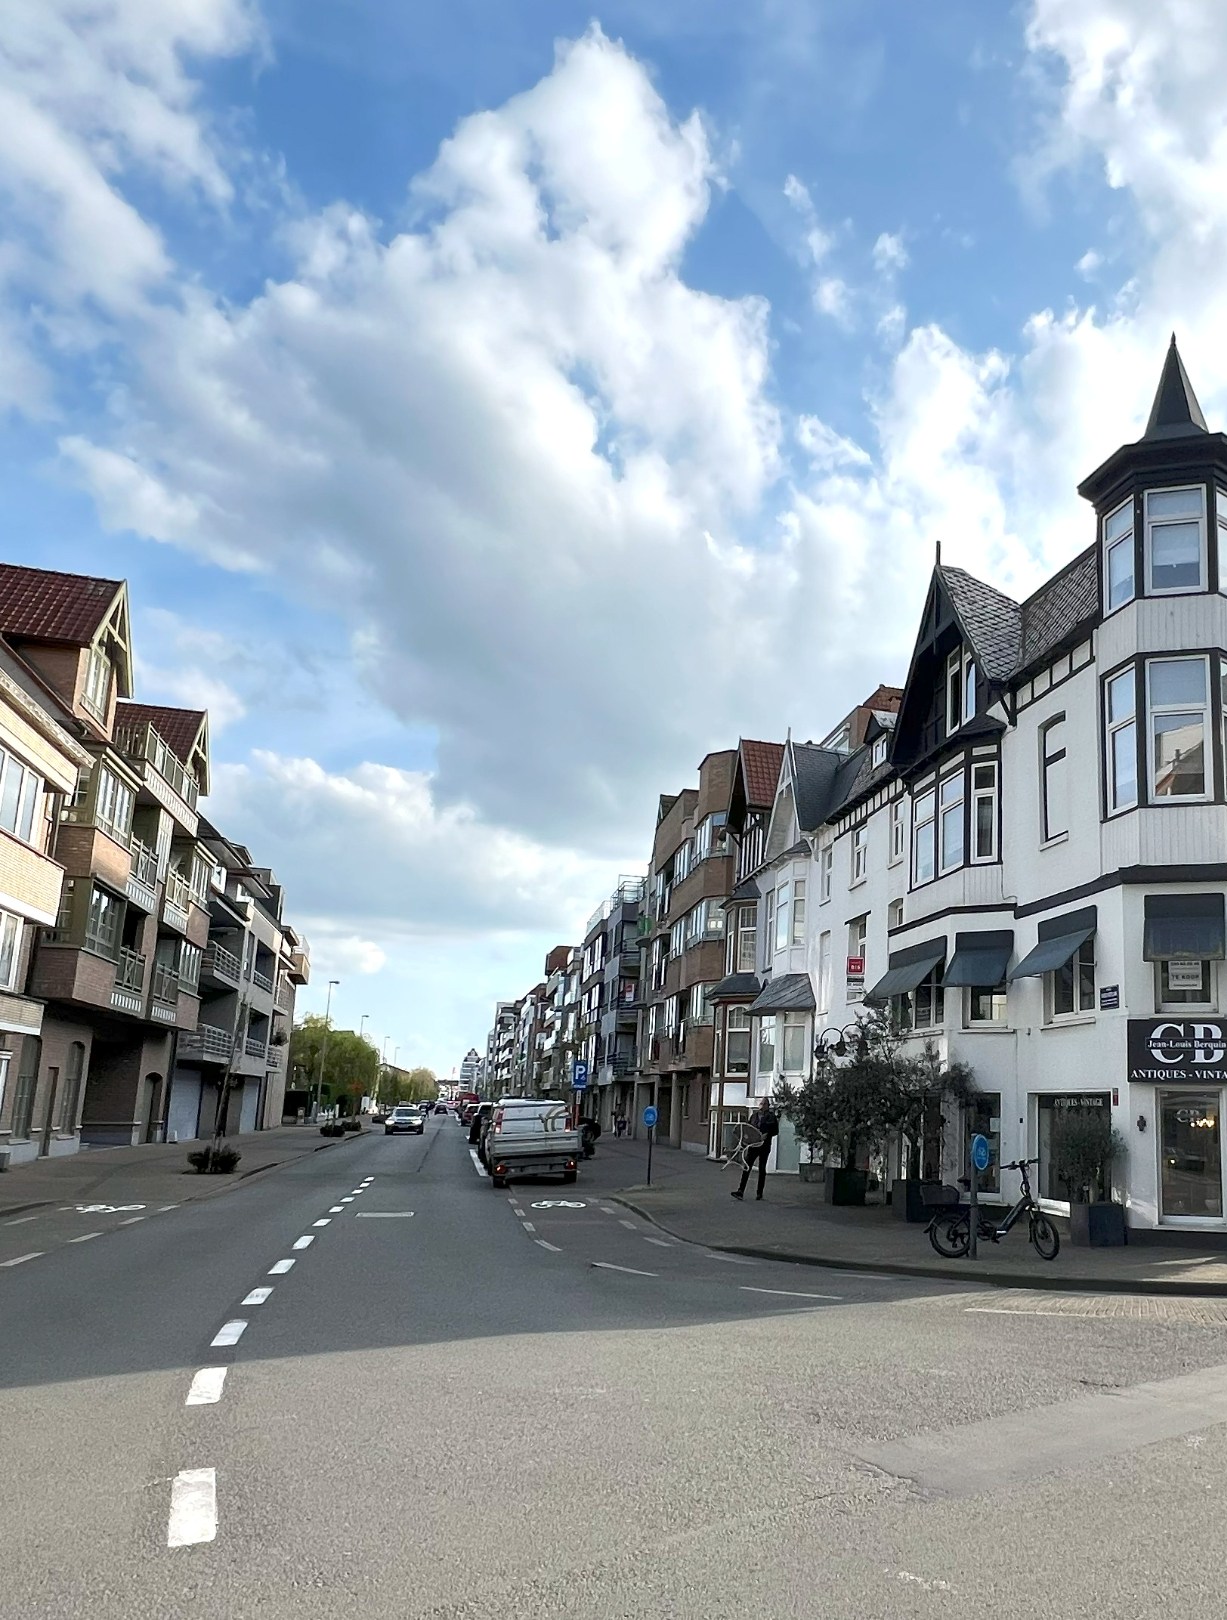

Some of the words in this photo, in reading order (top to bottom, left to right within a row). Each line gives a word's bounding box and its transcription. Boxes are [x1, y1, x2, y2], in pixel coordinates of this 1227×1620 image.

[1147, 1040, 1192, 1049] Jean-Louis
[1193, 1040, 1227, 1051] Berquin
[575, 1065, 586, 1080] P
[1130, 1069, 1187, 1081] ANTIQUES
